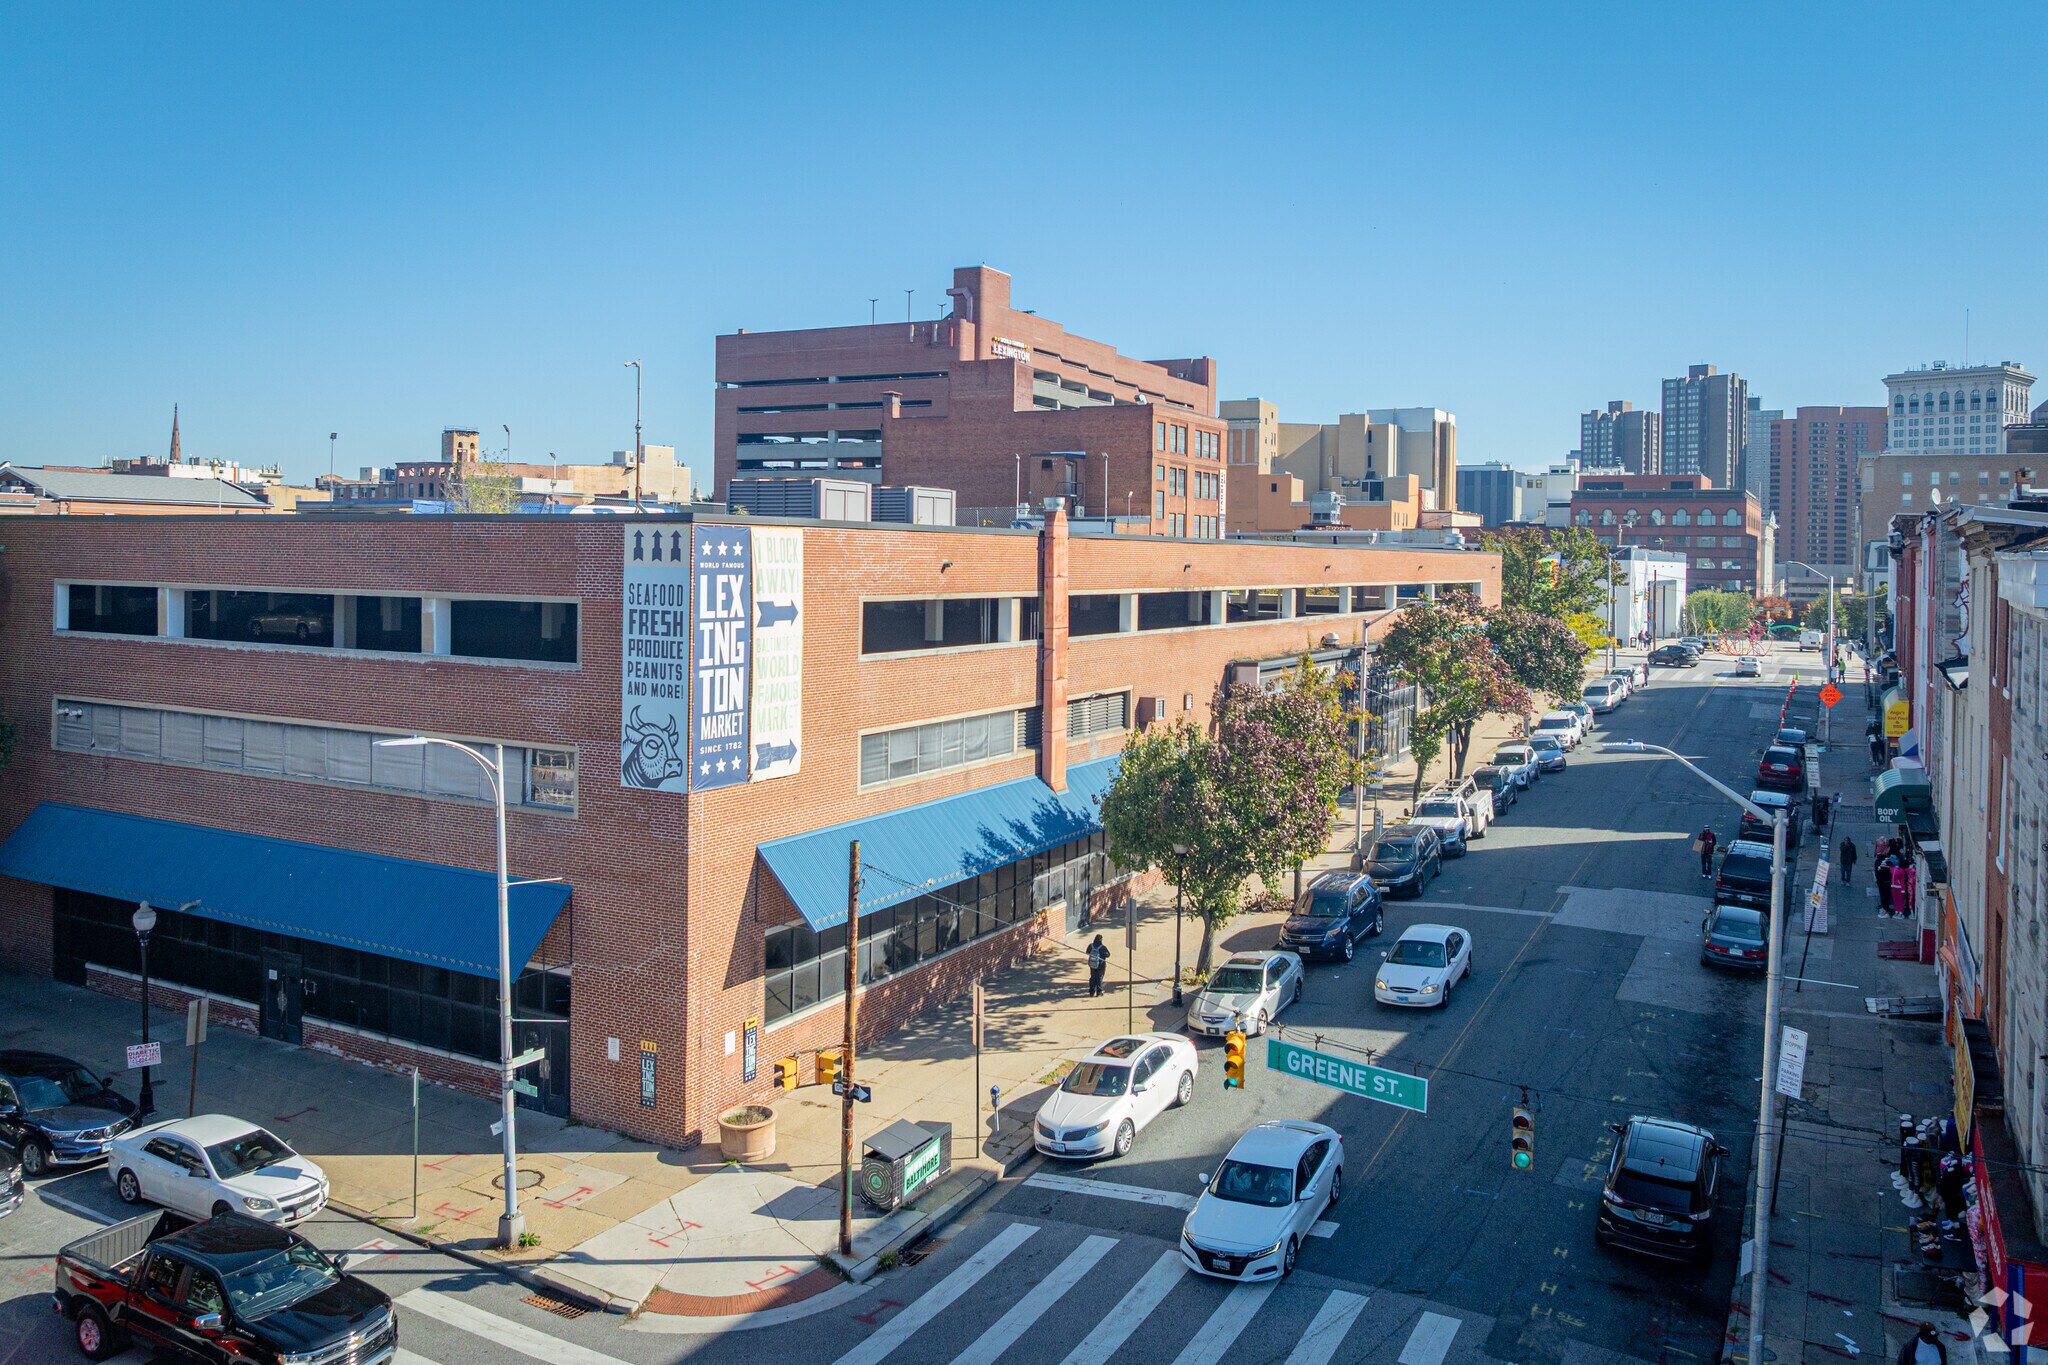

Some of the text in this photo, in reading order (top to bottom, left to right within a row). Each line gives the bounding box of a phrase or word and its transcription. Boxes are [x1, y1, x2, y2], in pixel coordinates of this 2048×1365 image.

[993, 343, 1030, 361] LEXINGTON
[766, 537, 799, 564] BLOCK
[756, 568, 799, 594] AWAY!
[628, 583, 684, 606] SEAFOOD
[699, 575, 744, 619] LEX
[629, 609, 684, 637] FRESH
[628, 638, 683, 660] PRODUCE
[699, 621, 744, 667] ING
[627, 661, 683, 681] PEANUTS
[756, 654, 799, 679] WORLD
[627, 681, 684, 699] AND MORE!
[699, 667, 744, 714] TON
[757, 681, 799, 705] FAMOUS
[700, 712, 744, 741] MARKET
[700, 741, 742, 755] SINCE 1782
[1877, 808, 1899, 816] BODY
[1879, 815, 1893, 823] OIL
[128, 1043, 159, 1051] CASH
[1784, 1040, 1804, 1051] STOPPING
[642, 1059, 654, 1071] LEX
[642, 1070, 654, 1082] ING
[1287, 1050, 1403, 1098] GREENE ST.
[1781, 1068, 1800, 1078] PARKING
[642, 1080, 654, 1092] TON
[906, 1154, 939, 1190] BALTIMORE
